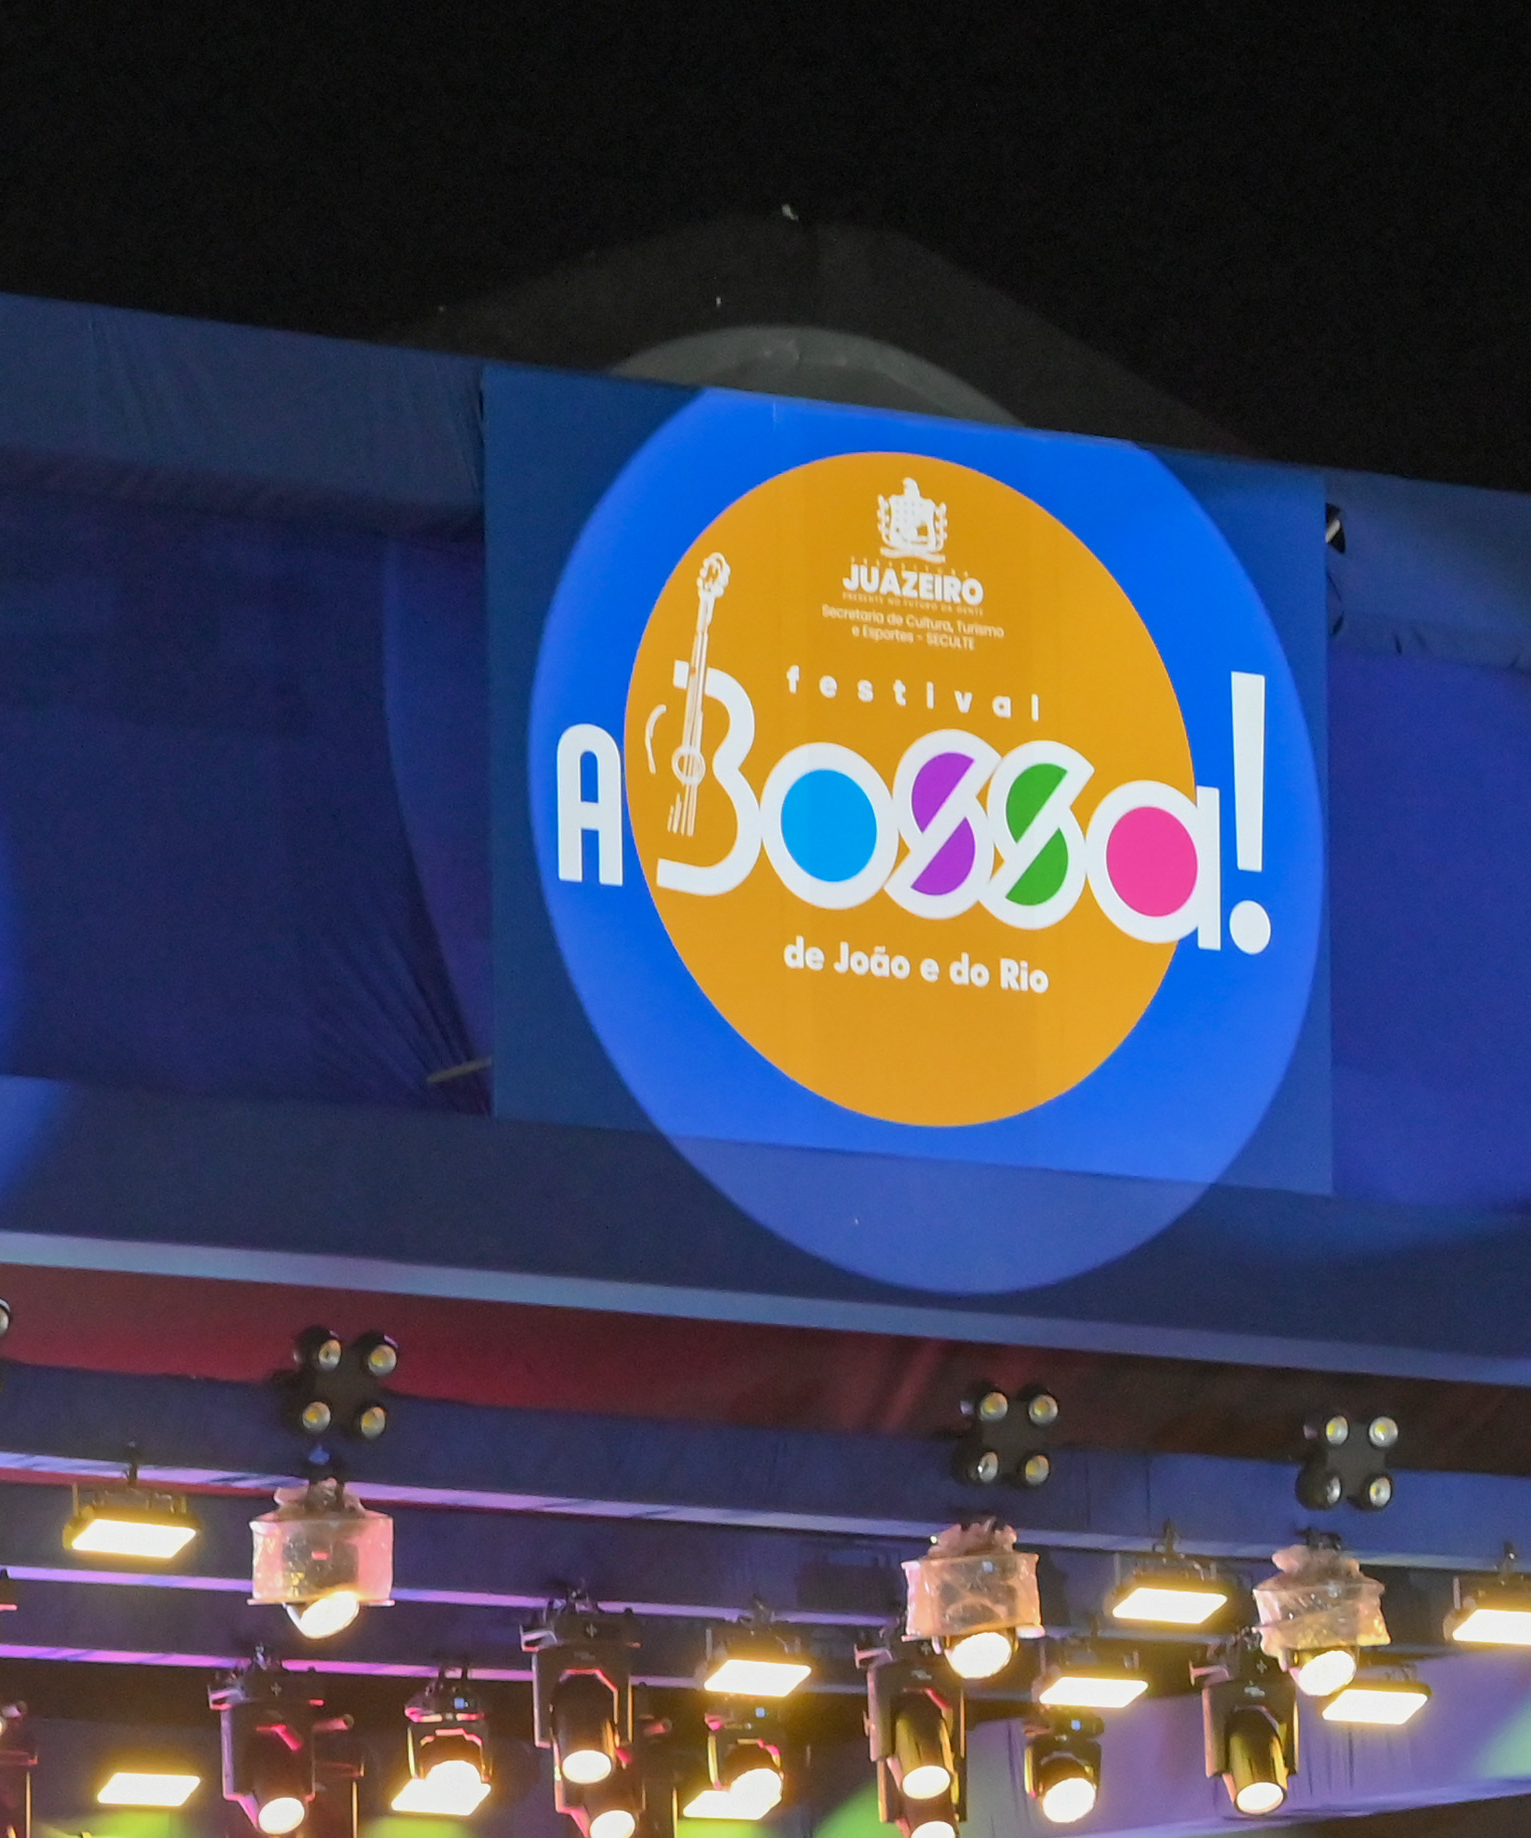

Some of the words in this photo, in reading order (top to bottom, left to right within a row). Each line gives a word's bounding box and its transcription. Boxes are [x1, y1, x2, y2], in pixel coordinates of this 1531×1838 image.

[842, 564, 984, 606] JUAZEIRO
[822, 604, 885, 625] Secretaria
[886, 614, 904, 626] de
[956, 620, 1007, 639] Turismo
[785, 664, 1041, 722] festival
[783, 935, 826, 971] de
[833, 940, 911, 980] João
[920, 958, 940, 983] e
[949, 951, 991, 988] do
[1000, 958, 1050, 994] Rio
